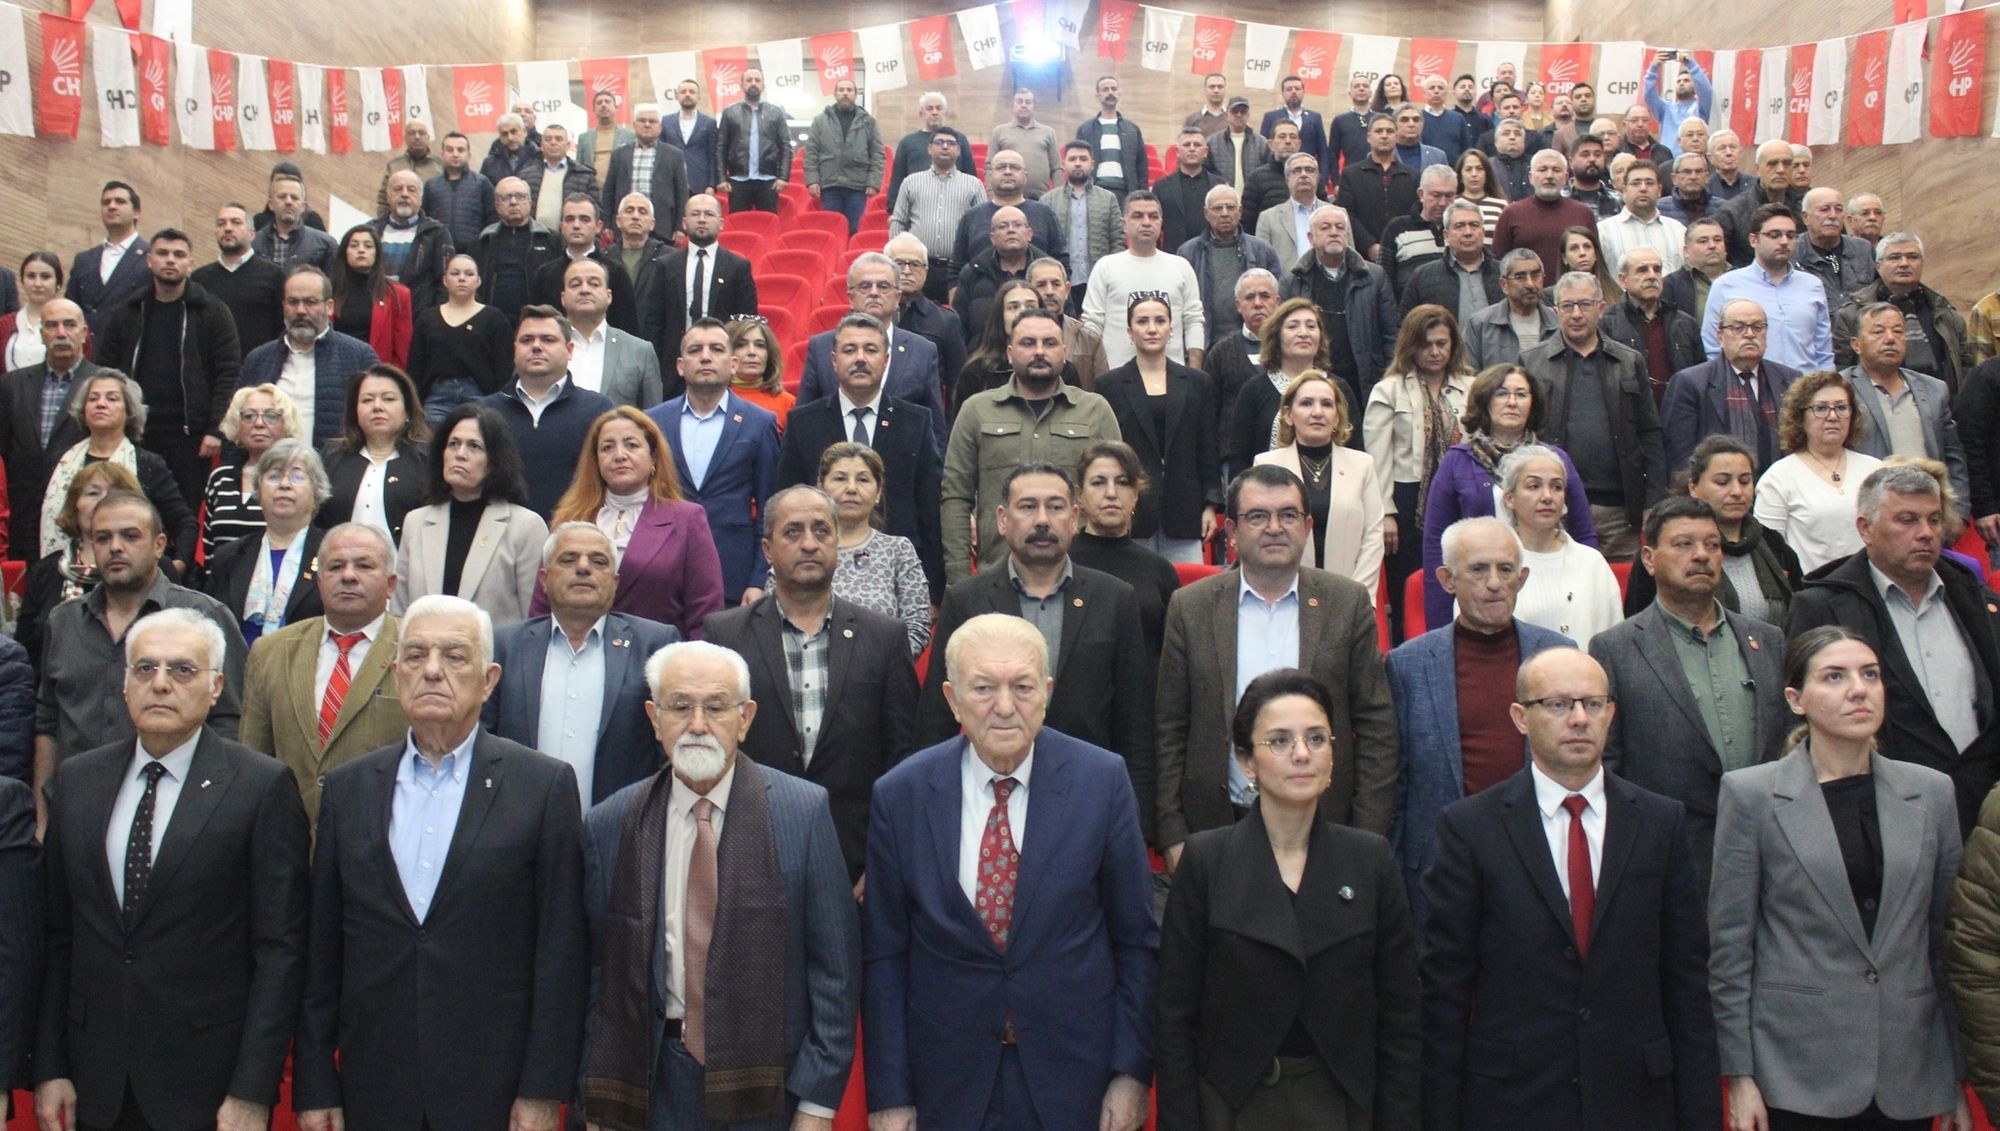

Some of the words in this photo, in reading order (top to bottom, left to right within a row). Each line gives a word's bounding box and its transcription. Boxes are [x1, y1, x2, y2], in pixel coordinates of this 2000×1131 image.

[973, 36, 997, 52] CHP
[1145, 40, 1169, 54] CHP
[923, 51, 943, 65] CHP
[1193, 47, 1217, 62] CHP
[823, 64, 850, 80] CHP
[875, 59, 899, 74] CHP
[1246, 58, 1272, 72] CHP
[1297, 66, 1323, 80] CHP
[775, 73, 801, 88] CHP
[715, 83, 742, 97] CHP
[1547, 82, 1574, 95] CHP
[1607, 81, 1639, 95] CHP
[464, 102, 494, 117] CHP
[533, 99, 563, 113] CHP
